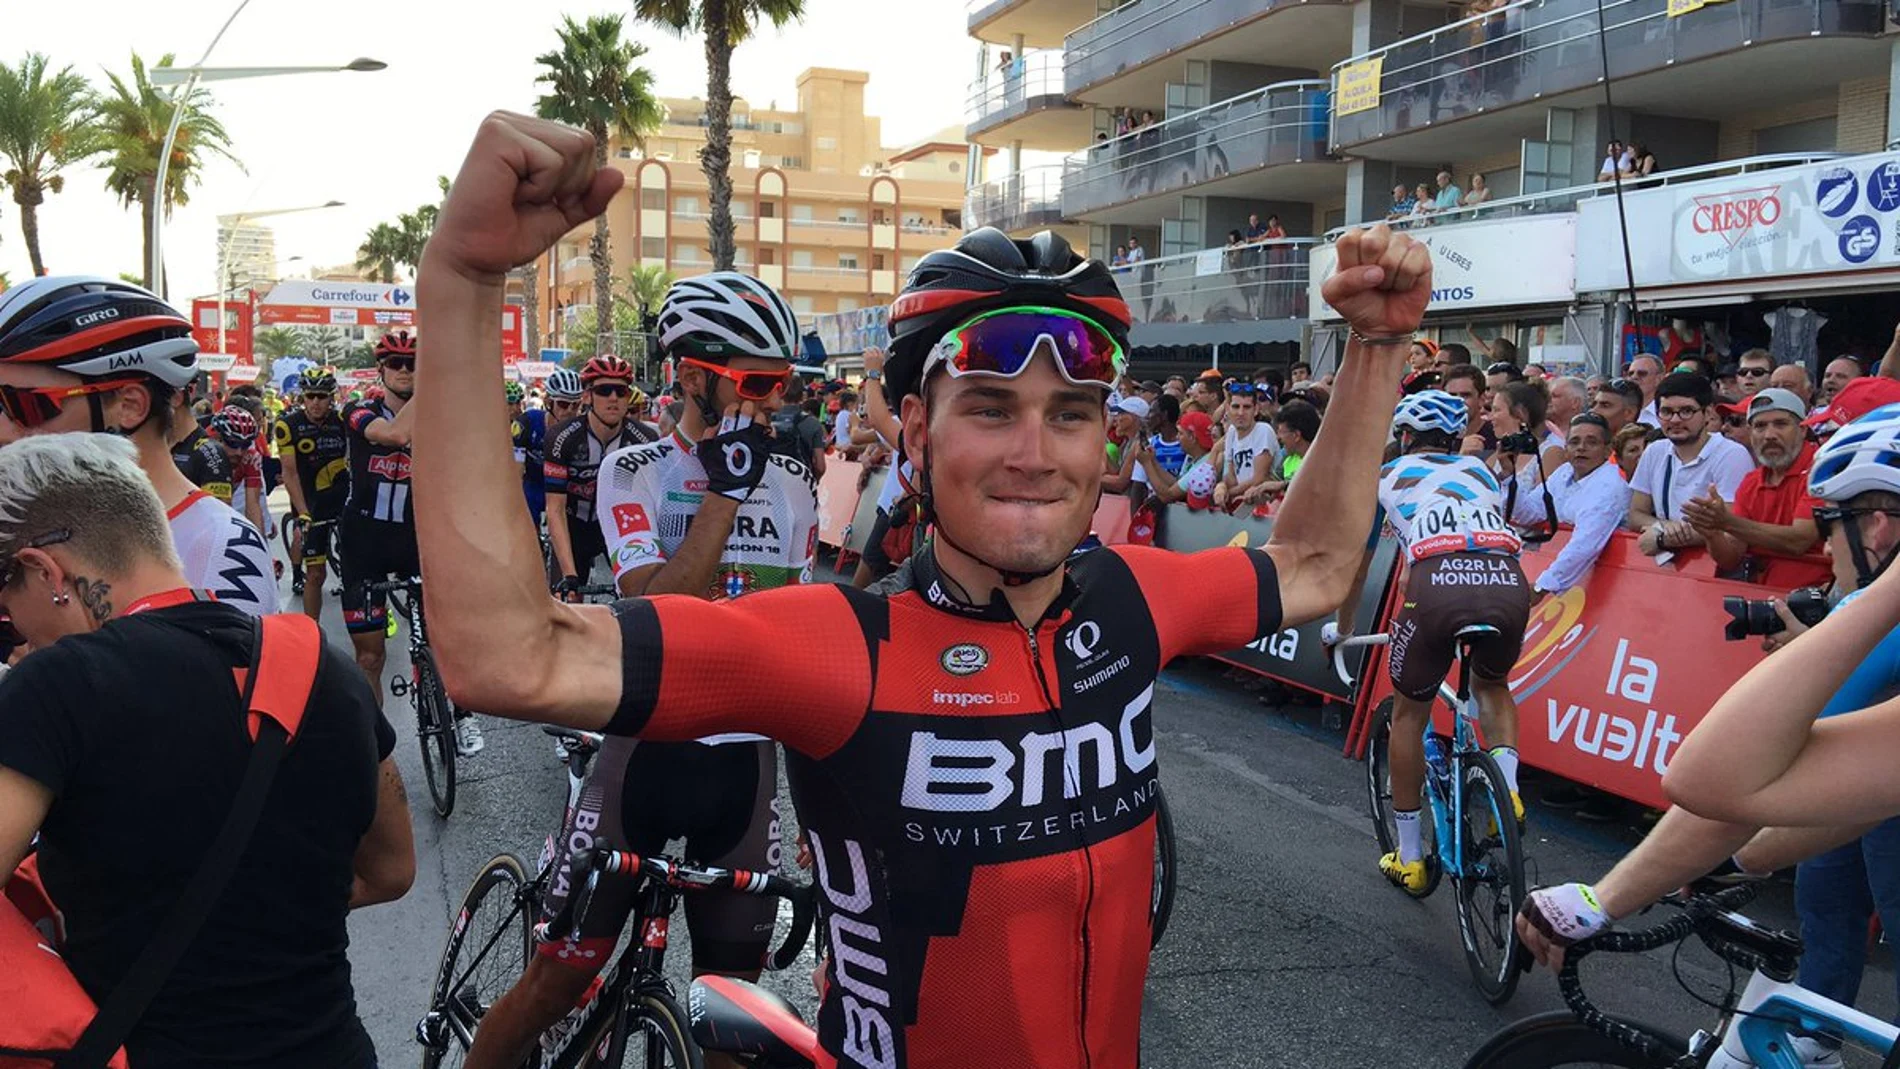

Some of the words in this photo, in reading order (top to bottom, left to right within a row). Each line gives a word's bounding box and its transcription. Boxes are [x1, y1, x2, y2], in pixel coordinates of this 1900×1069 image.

[1692, 195, 1781, 234] CRESPO
[311, 287, 379, 303] Carrefour
[1430, 286, 1475, 302] NTOS
[75, 307, 120, 327] GIRO
[108, 351, 144, 371] IAM
[374, 458, 411, 474] Alpeci
[615, 444, 674, 475] BORA
[1416, 505, 1458, 541] 104
[1431, 572, 1519, 586] MONDIALE
[1439, 558, 1485, 572] AG2R
[1488, 558, 1509, 571] LA
[1390, 619, 1417, 683] MONDIALE
[1073, 654, 1131, 695] SHIMANO
[1605, 637, 1659, 704] la
[1547, 698, 1681, 777] vuelt
[906, 778, 1159, 846] SWITZERLAND
